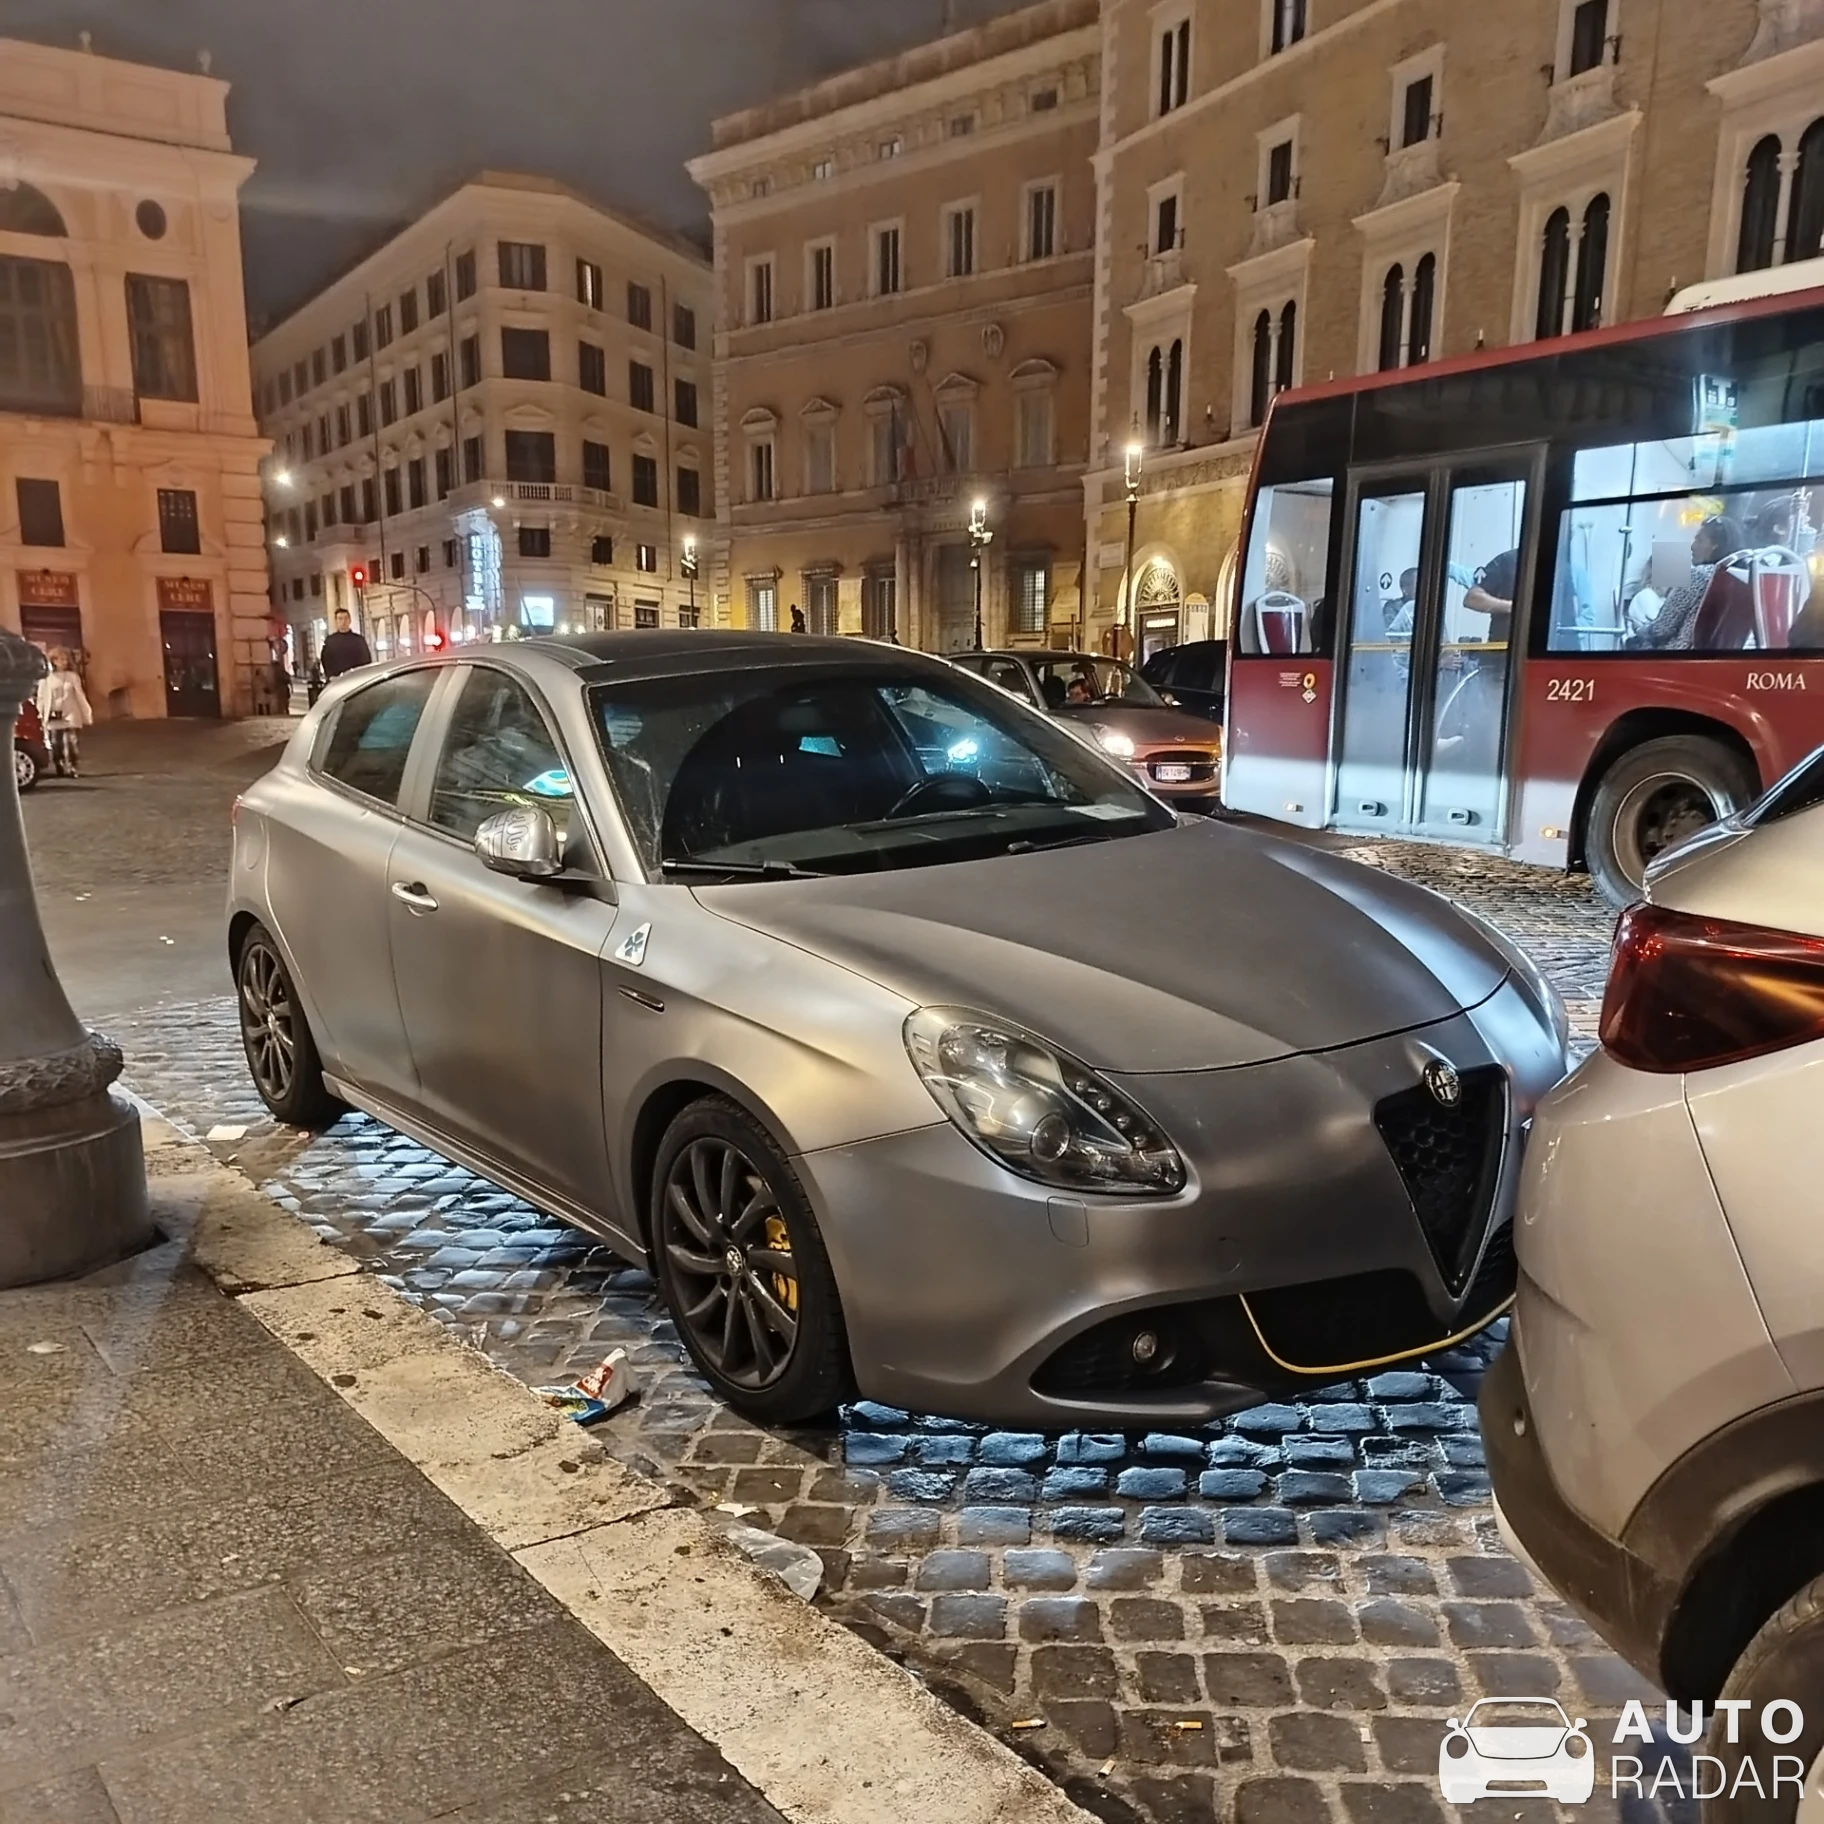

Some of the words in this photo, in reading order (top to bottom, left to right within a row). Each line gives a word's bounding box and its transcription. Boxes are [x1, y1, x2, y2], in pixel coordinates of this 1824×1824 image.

[471, 535, 484, 595] HOTEL
[1546, 679, 1595, 701] 2421
[1746, 673, 1806, 690] ROMA
